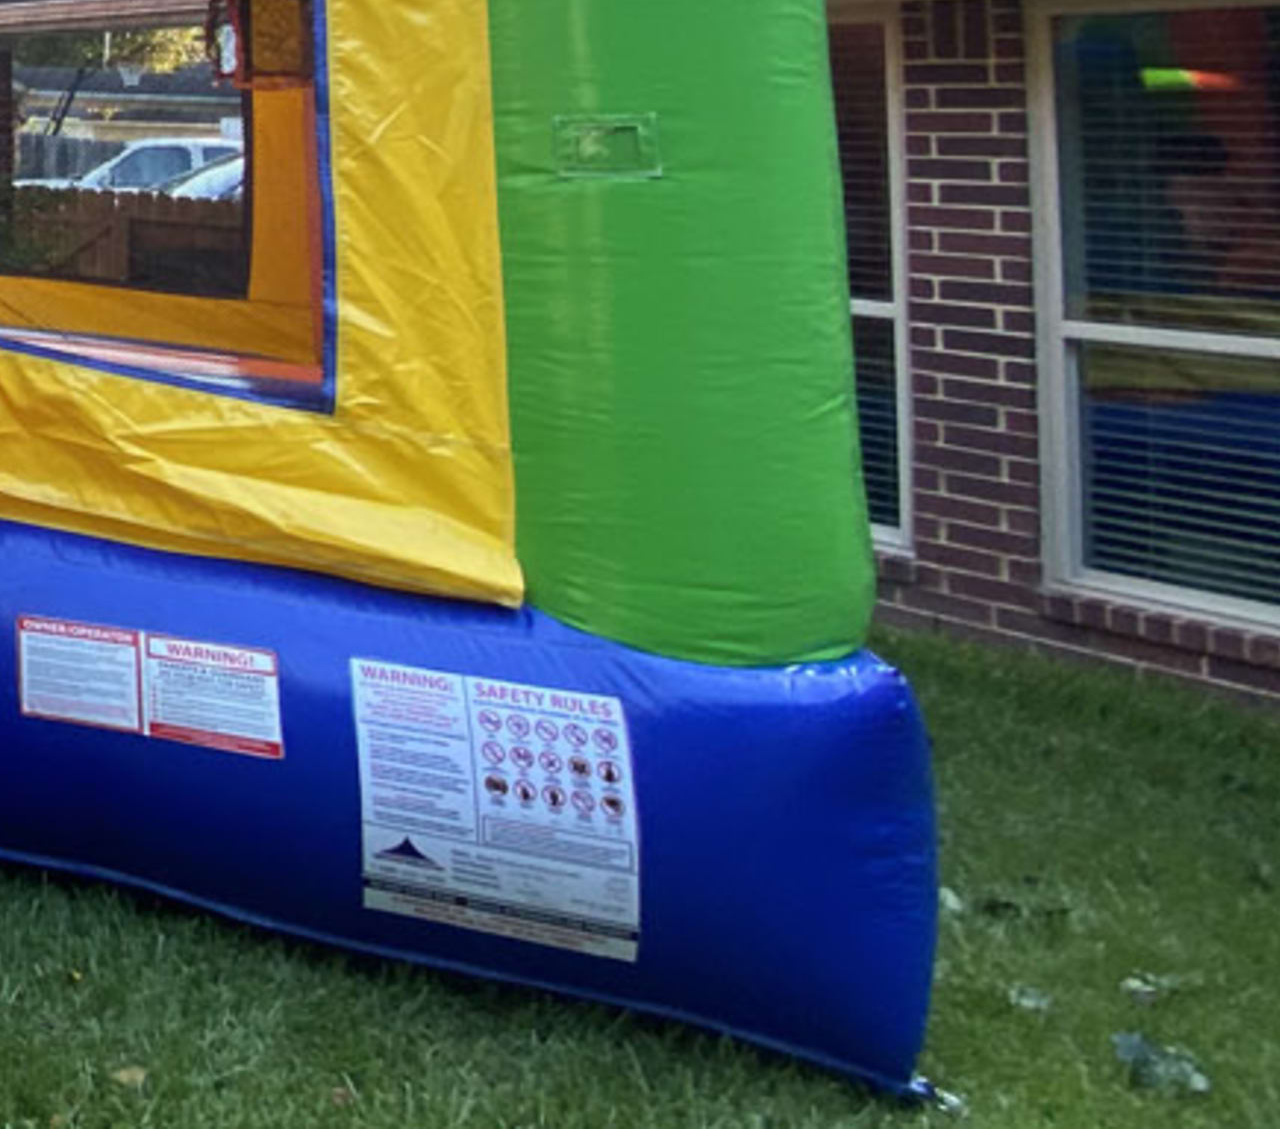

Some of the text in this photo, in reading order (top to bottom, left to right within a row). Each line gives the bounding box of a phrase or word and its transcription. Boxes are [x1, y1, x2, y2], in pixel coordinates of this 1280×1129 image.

[166, 642, 254, 667] WARNING!
[474, 681, 545, 707] SAFETY
[549, 693, 612, 719] RULES
